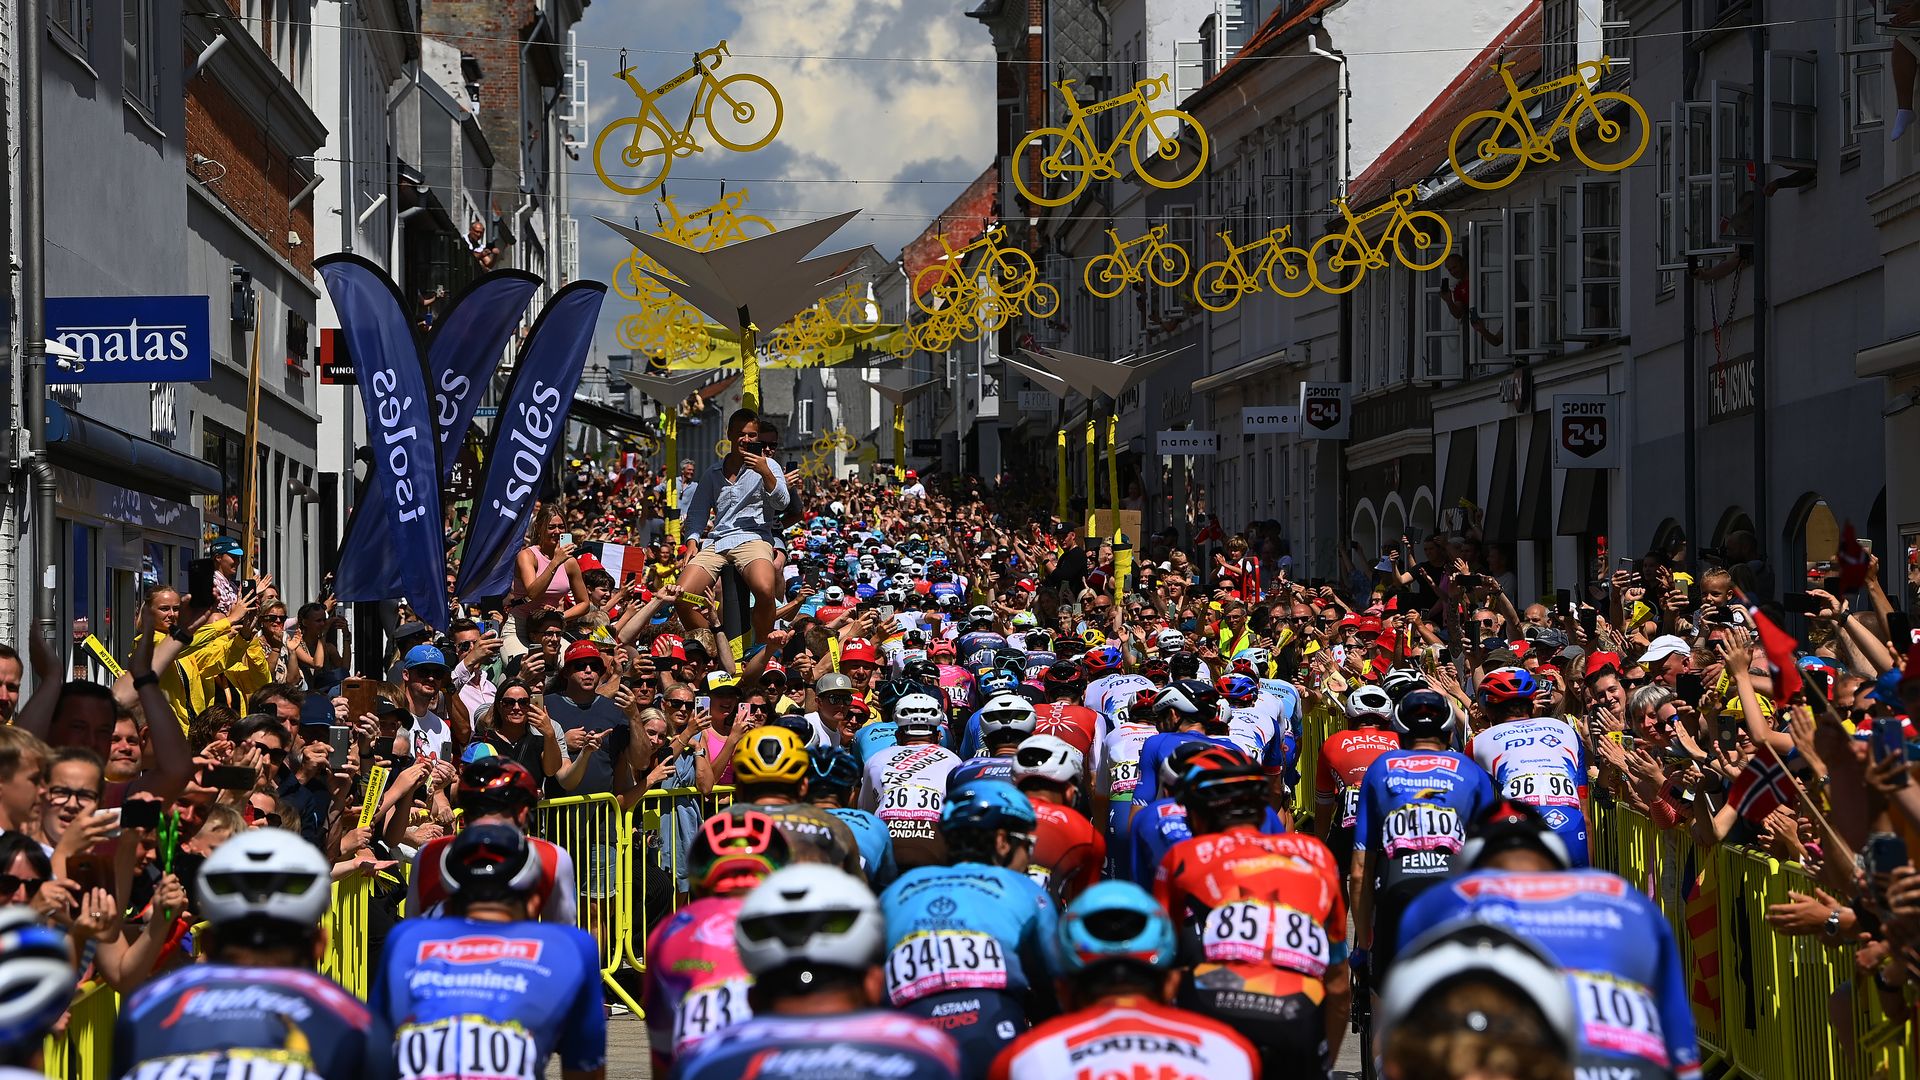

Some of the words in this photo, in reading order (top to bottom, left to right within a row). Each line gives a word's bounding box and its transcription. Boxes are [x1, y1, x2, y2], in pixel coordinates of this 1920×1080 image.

[664, 81, 675, 91] City
[674, 75, 685, 86] Vejle
[1539, 84, 1550, 92] City
[1550, 80, 1562, 90] Vejle
[1094, 104, 1106, 112] City
[1106, 99, 1120, 109] Vejle
[56, 318, 189, 362] matas
[1307, 388, 1340, 397] SPORT
[1311, 403, 1338, 421] 24
[1562, 402, 1606, 414] SPORT
[1247, 415, 1288, 424] name
[1161, 438, 1198, 447] name
[1203, 437, 1213, 447] it
[1568, 423, 1604, 446] 24
[493, 380, 560, 520] isolés
[1109, 679, 1130, 690] FDJ
[869, 728, 898, 737] AST
[1493, 726, 1564, 741] Groupama
[1341, 735, 1399, 750] ARKEA
[1505, 738, 1534, 751] FDJ
[887, 748, 919, 768] AG2R
[1394, 758, 1451, 770] Alpecin
[891, 751, 949, 786] MONDIALE
[1113, 764, 1139, 781] 187
[882, 771, 898, 787] LA
[1387, 776, 1454, 791] deceuninck
[1510, 778, 1534, 797] 96
[1550, 777, 1573, 796] 96
[885, 788, 908, 809] 36
[917, 789, 941, 810] 36
[887, 820, 915, 830] AG2R
[917, 820, 931, 830] LA
[1387, 810, 1418, 843] 104
[1426, 811, 1463, 842] 104
[1402, 852, 1447, 868] FENIX
[1217, 905, 1257, 941] 85
[1287, 913, 1321, 956] 85
[431, 941, 528, 960] Alpecin
[890, 939, 936, 989] 134
[945, 937, 1001, 970] 134
[677, 986, 732, 1038] 143
[931, 999, 981, 1016] ASTANA
[1071, 1037, 1206, 1065] SOUDAL
